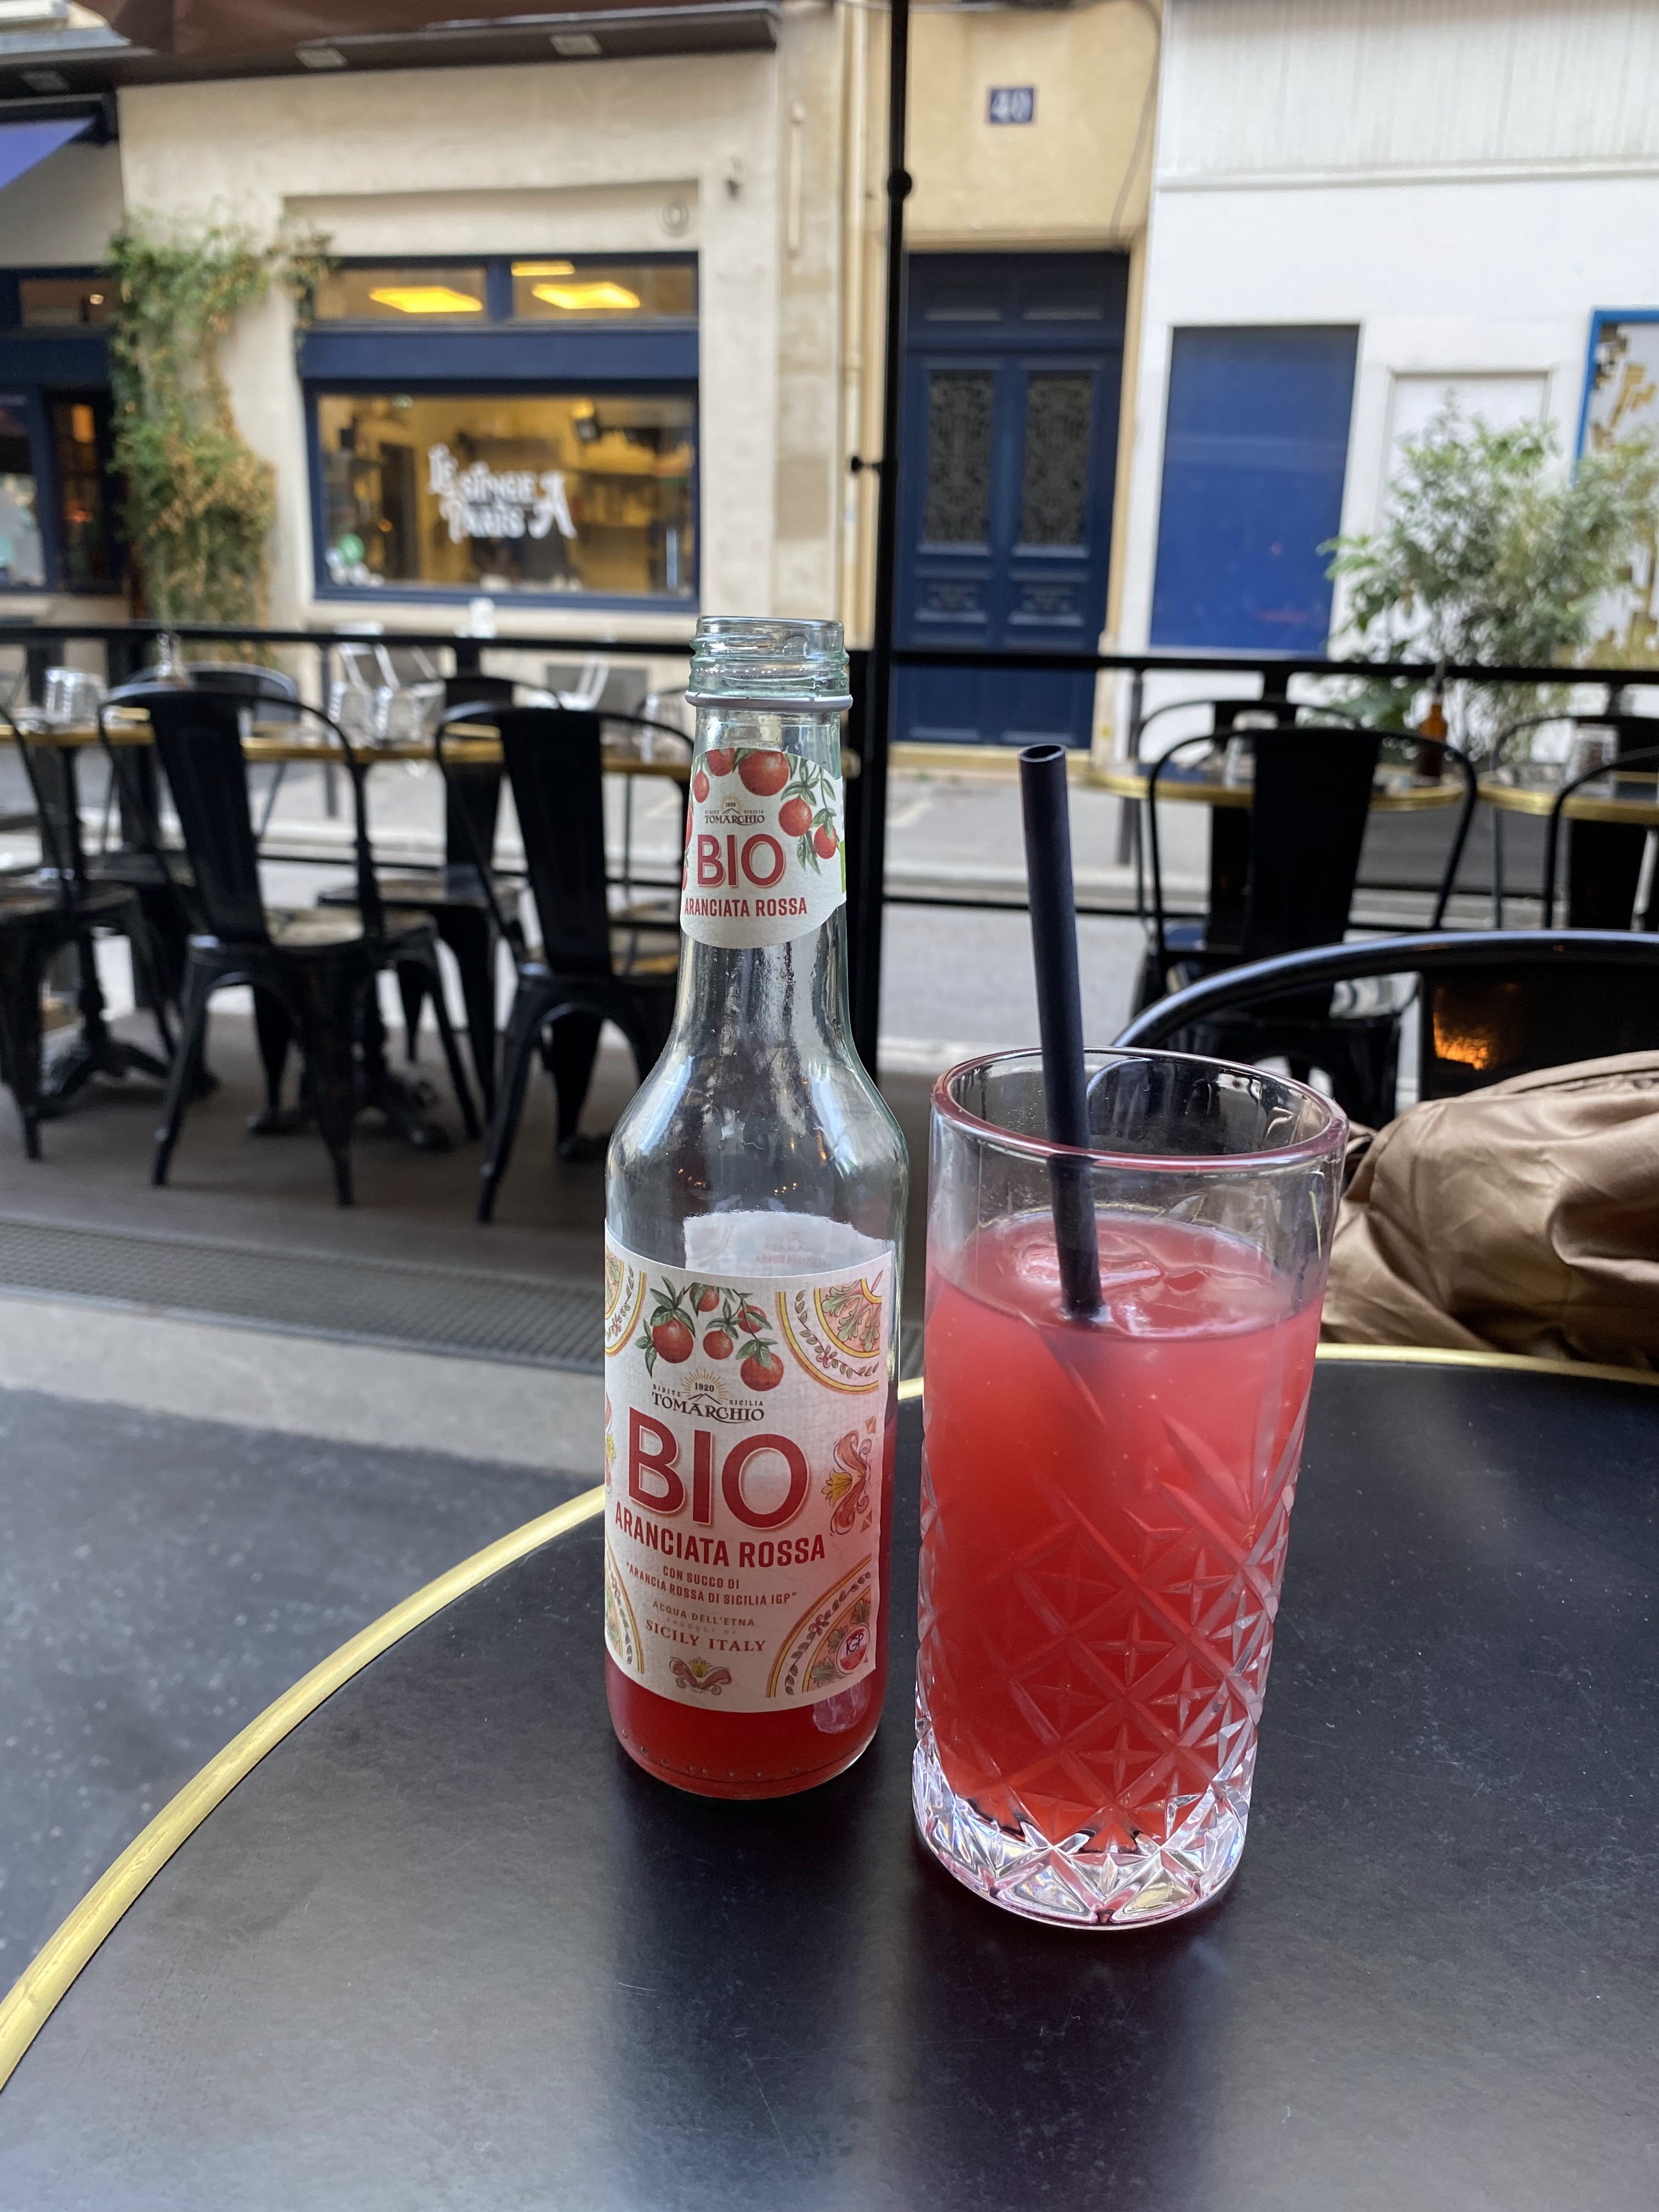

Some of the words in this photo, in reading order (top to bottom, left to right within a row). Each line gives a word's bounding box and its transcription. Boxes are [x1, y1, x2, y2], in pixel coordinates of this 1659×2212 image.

[705, 815, 765, 826] TOMARCHIO
[697, 834, 785, 887] BIO
[684, 897, 750, 917] ARANCIATA
[756, 897, 807, 917] ROSSA
[694, 1381, 714, 1393] 1920
[651, 1391, 765, 1424] TOMARCHIO
[629, 1407, 809, 1529] BIO
[616, 1501, 729, 1567] ARANCIATA
[739, 1534, 825, 1568] ROSSA
[663, 1565, 683, 1582] CON
[687, 1572, 724, 1589] SUCCO
[727, 1578, 740, 1589] DI
[669, 1584, 704, 1601] ROSSA
[708, 1592, 720, 1604] DI
[724, 1594, 767, 1605] SICILIA
[652, 1601, 687, 1618] ACQUA
[692, 1613, 755, 1626] DELL'ETNA
[667, 1617, 715, 1633] PRODUCT
[646, 1620, 699, 1646] SICILY
[709, 1638, 766, 1651] ITALY
[846, 1633, 864, 1655] IGP
